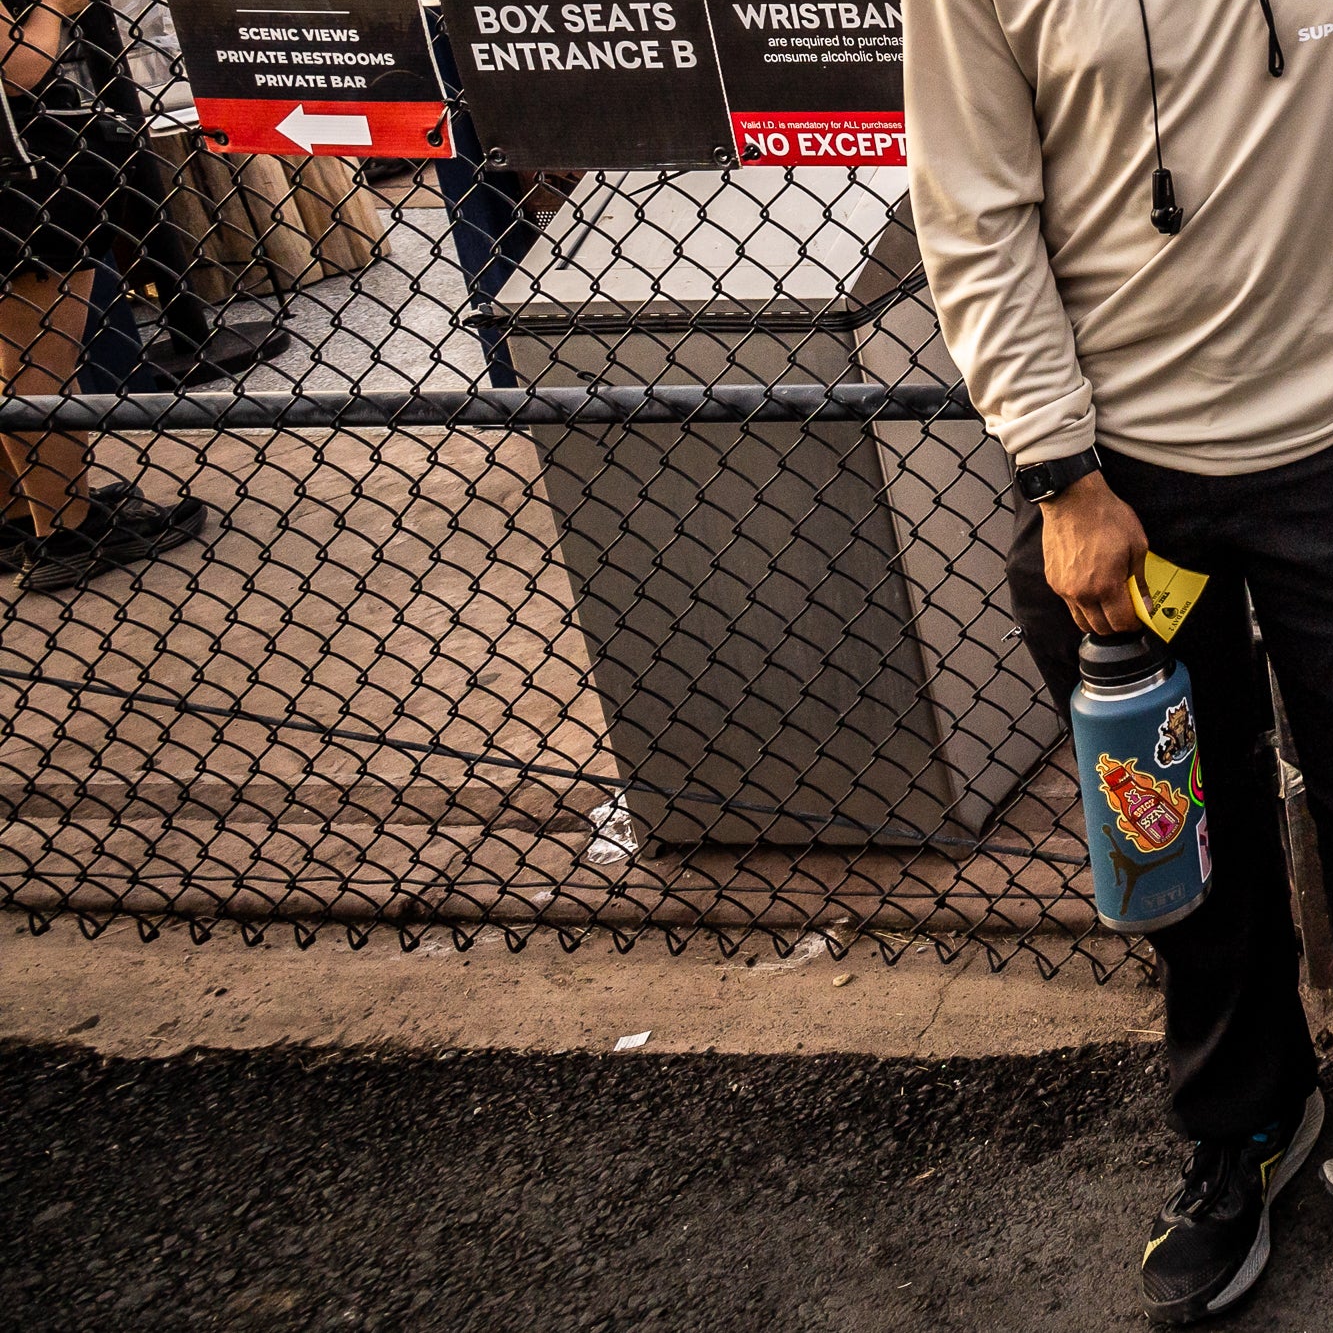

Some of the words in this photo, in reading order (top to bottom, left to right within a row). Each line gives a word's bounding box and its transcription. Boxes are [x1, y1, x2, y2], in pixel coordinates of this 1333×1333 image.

[473, 4, 555, 34] BOX
[560, 2, 677, 33] SEATS
[238, 27, 299, 42] SCENIC
[302, 28, 360, 43] VIEWS
[768, 37, 787, 47] are
[791, 35, 839, 49] required
[842, 35, 855, 47] to
[216, 50, 288, 65] PRIVATE
[291, 51, 395, 67] RESTROOMS
[470, 40, 664, 71] ENTRANCE
[670, 40, 698, 69] B
[763, 51, 818, 63] consume
[821, 50, 873, 63] alcoholic
[255, 73, 328, 88] PRIVATE
[330, 74, 368, 89] BAR
[740, 121, 761, 130] Valid
[762, 121, 777, 130] I.D.
[778, 121, 786, 130] is
[787, 121, 829, 131] mandatory
[831, 121, 842, 129] for
[843, 121, 860, 129] ALL
[861, 121, 902, 130] purchases
[744, 132, 790, 157] NO
[1133, 798, 1155, 818] SPICY
[1140, 805, 1166, 829] SZN
